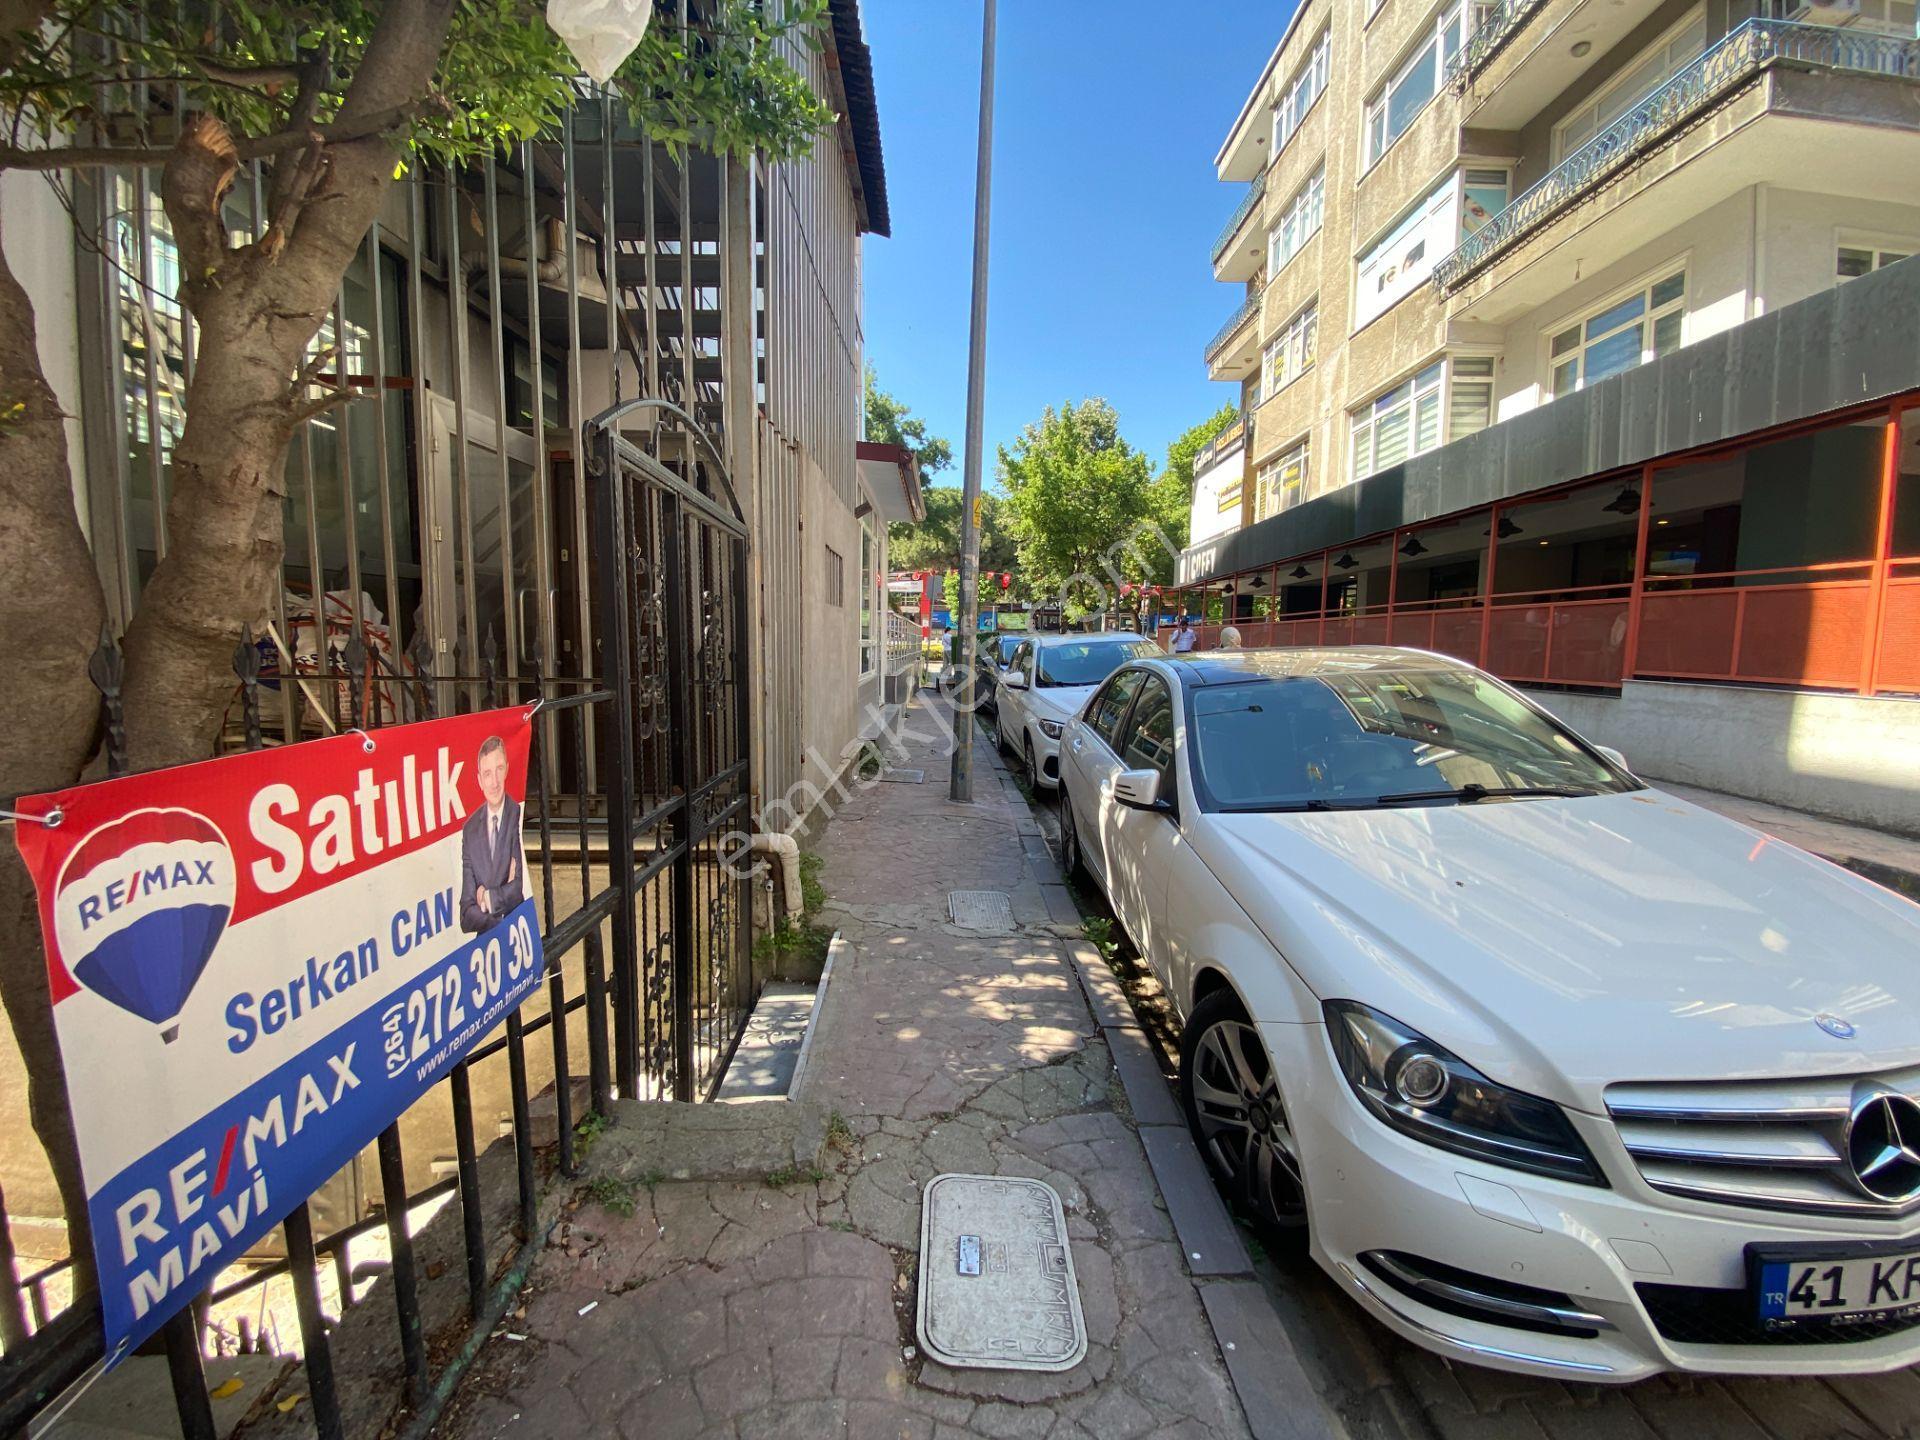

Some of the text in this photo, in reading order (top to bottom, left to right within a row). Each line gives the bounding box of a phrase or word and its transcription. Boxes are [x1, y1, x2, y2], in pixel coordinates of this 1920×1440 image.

[248, 746, 466, 894] Satılık
[78, 860, 215, 930] RE/MAX
[224, 887, 453, 1054] Serkan CAN
[382, 915, 534, 1079] (264) 272 30 30
[116, 1041, 361, 1266] RE/MAX
[1766, 1292, 1784, 1304] TR
[1789, 1266, 1847, 1309] 41
